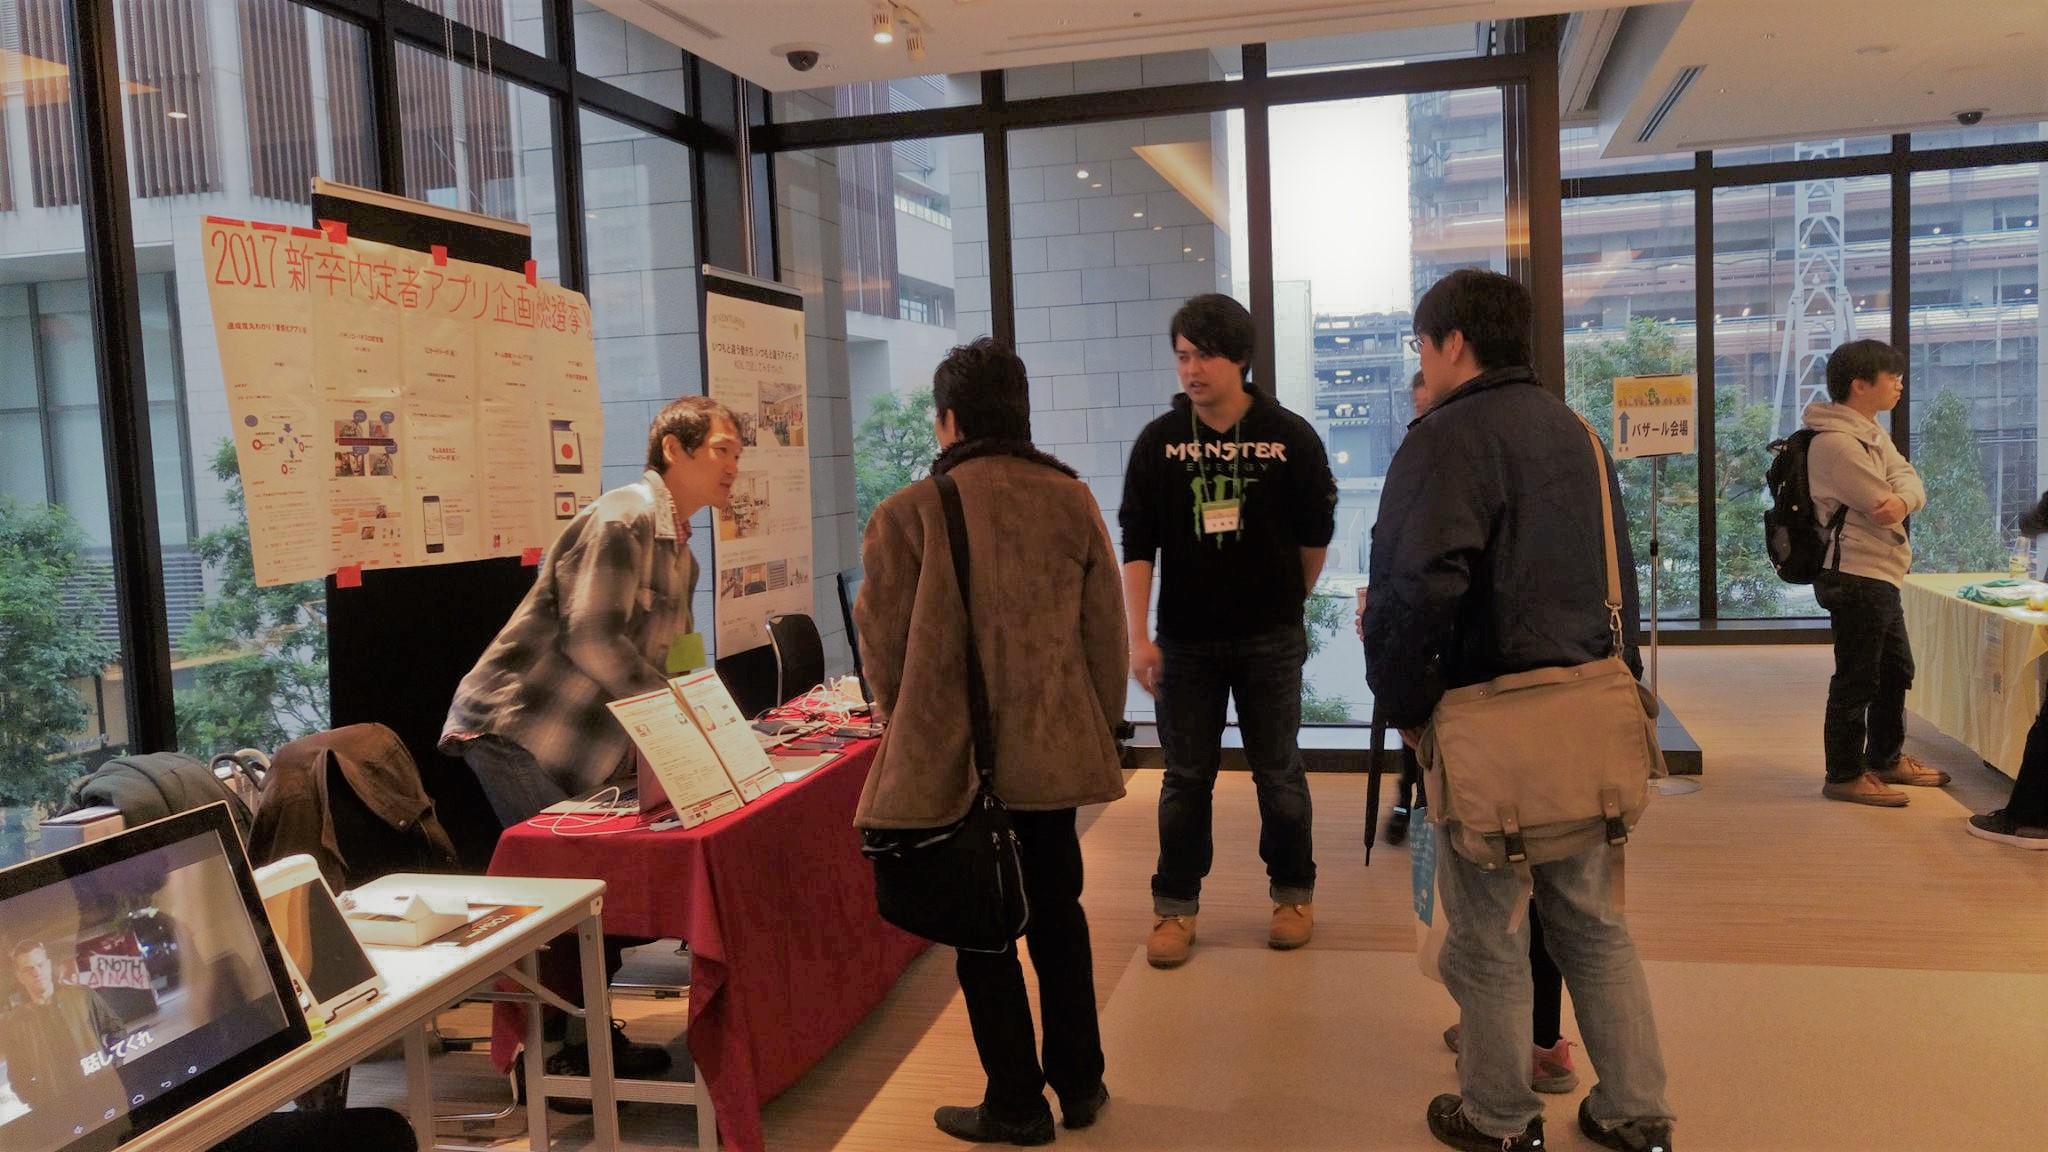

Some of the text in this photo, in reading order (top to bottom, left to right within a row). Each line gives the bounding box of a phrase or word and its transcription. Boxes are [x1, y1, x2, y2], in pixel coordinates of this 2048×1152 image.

[1632, 419, 1688, 438] バザール会場
[1164, 439, 1288, 462] MONSTER
[80, 1030, 155, 1078] 話してくれ
